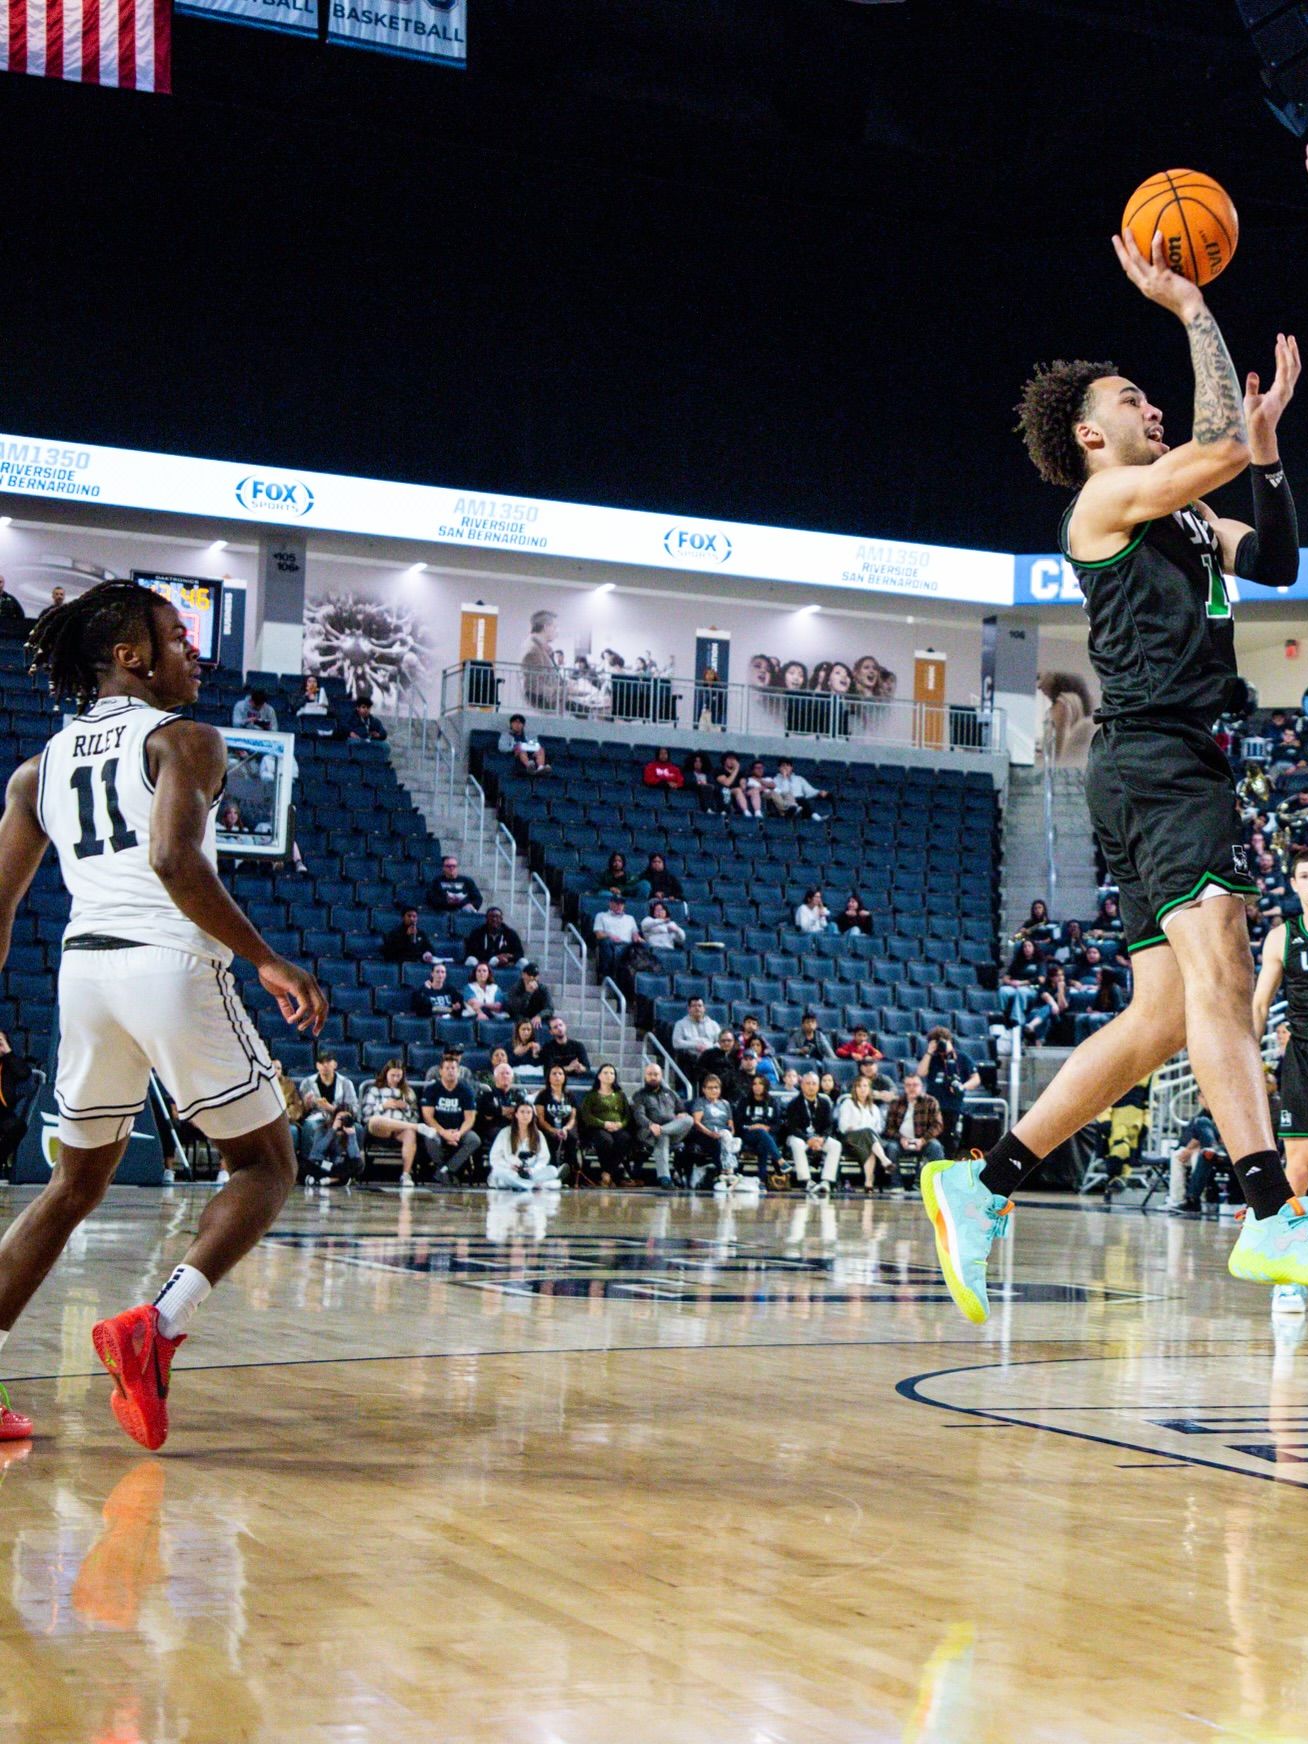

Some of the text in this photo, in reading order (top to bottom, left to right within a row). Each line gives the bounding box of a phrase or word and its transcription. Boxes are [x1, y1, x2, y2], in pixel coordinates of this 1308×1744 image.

[333, 3, 464, 43] BASKETBALL
[0, 462, 76, 481] RIVERSIDE
[8, 475, 100, 497] BERNARDINO
[252, 480, 297, 503] FOX
[454, 498, 539, 522] AM1350
[461, 516, 525, 533] RIVERSIDE
[438, 525, 548, 548] SAN BERNARDINO
[678, 531, 717, 552] FOX
[842, 571, 938, 591] SAN BERNARDINO
[862, 562, 919, 578] RIVERSIDE
[72, 715, 127, 758] RILEY
[70, 757, 139, 860] 11
[438, 1096, 459, 1107] CBU
